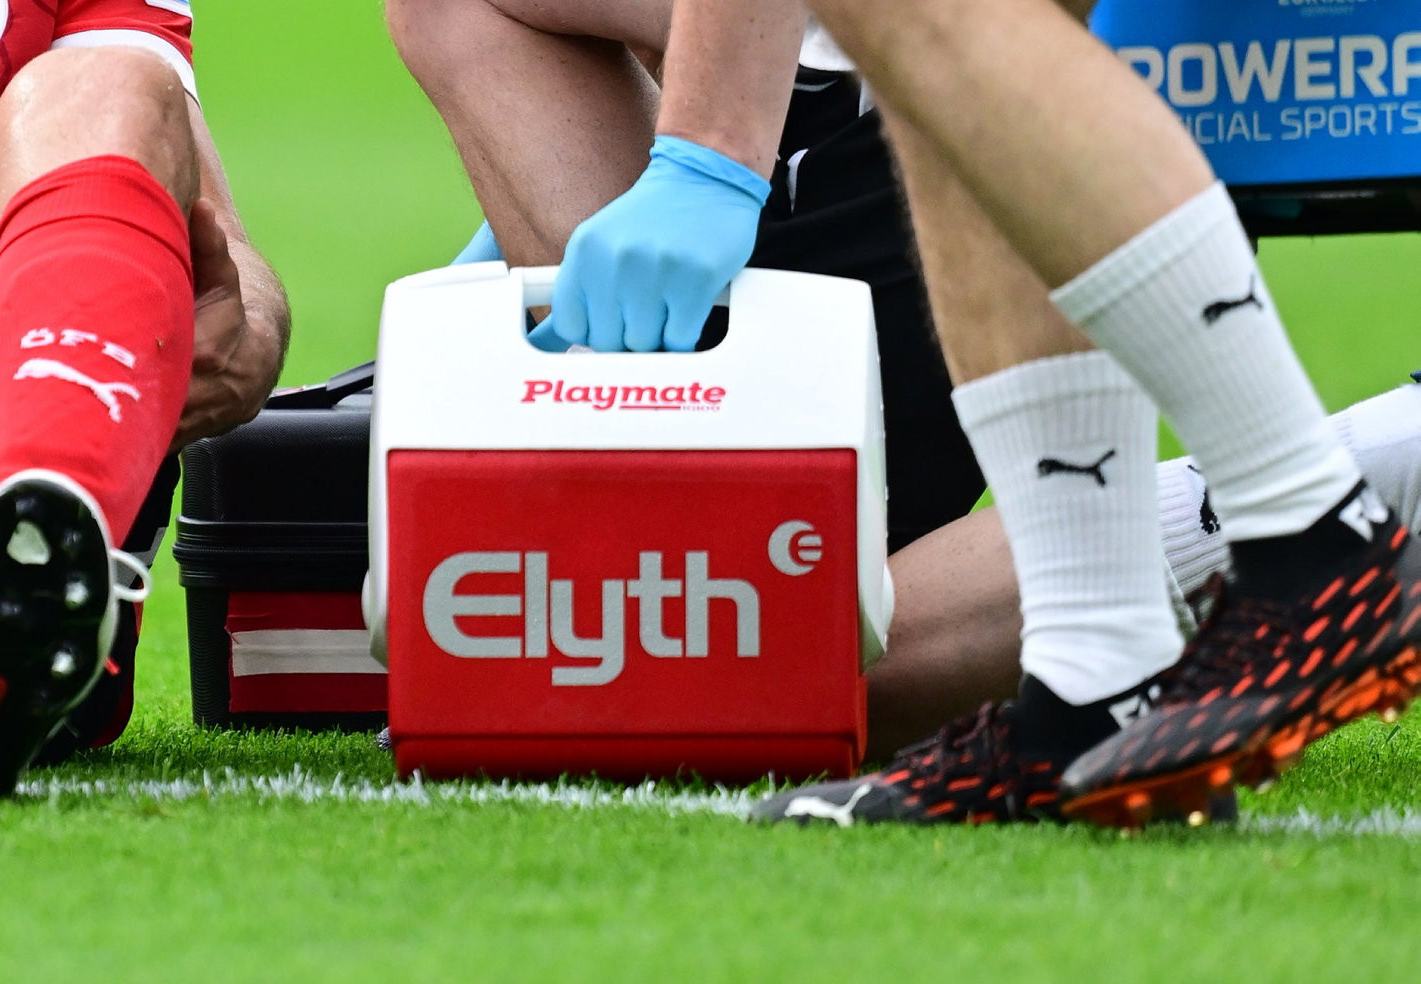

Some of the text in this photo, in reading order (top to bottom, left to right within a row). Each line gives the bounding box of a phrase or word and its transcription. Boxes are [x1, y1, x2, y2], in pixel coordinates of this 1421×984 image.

[1280, 100, 1421, 140] SPORTS
[521, 379, 726, 411] Playmate
[423, 551, 760, 686] Elyth
